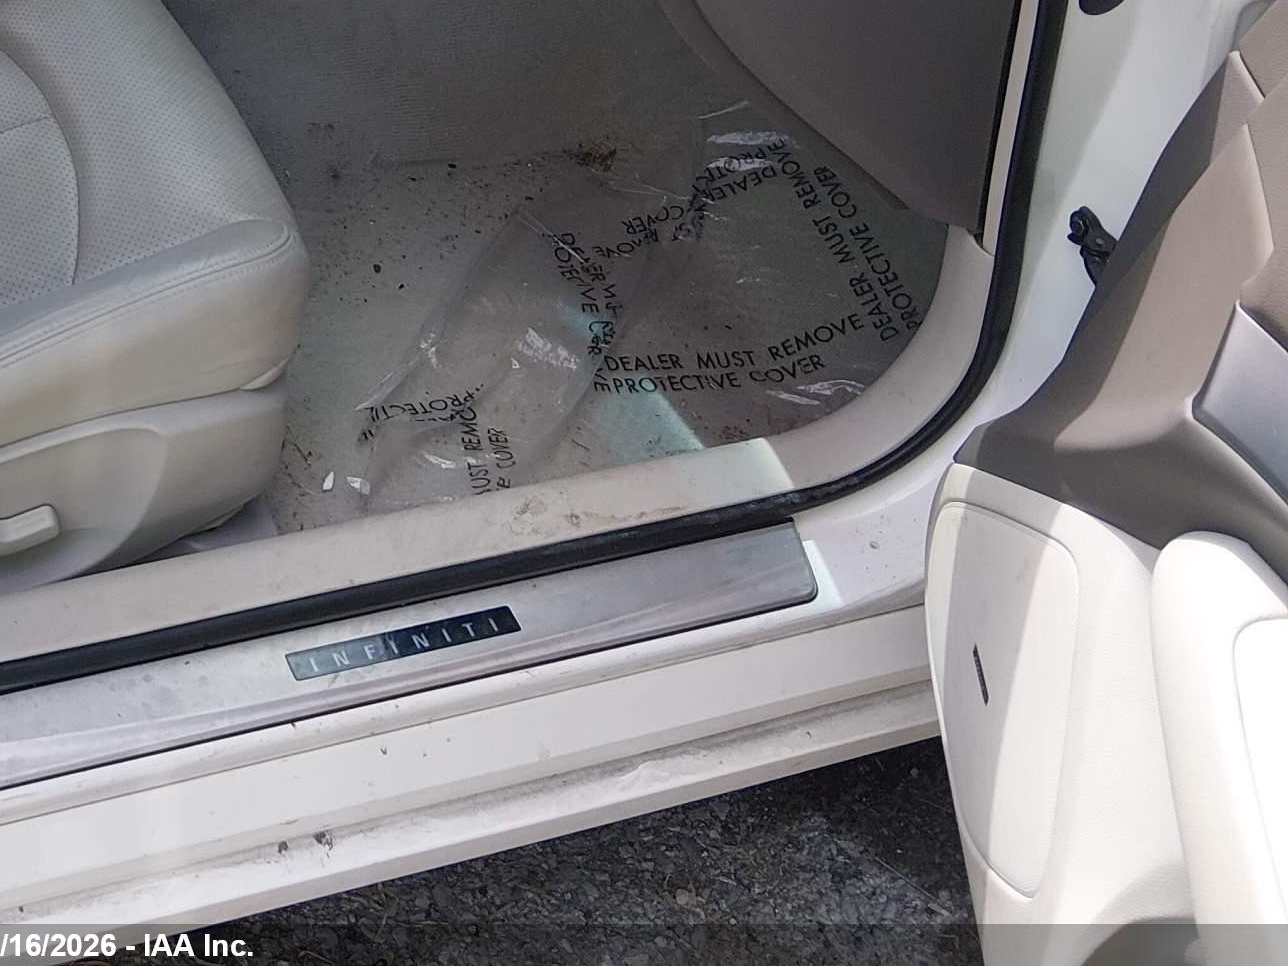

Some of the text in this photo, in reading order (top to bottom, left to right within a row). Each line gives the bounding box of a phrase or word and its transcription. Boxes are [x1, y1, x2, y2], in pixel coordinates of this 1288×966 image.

[622, 205, 685, 234] COVER
[766, 138, 899, 342] DEALER MUST REMOVE
[813, 165, 923, 331] PROTECTIVE COVER
[604, 313, 865, 372] DEALER MUST REMOVE
[614, 354, 825, 394] PROTECTIVE COVER
[309, 618, 499, 673] INFINITI
